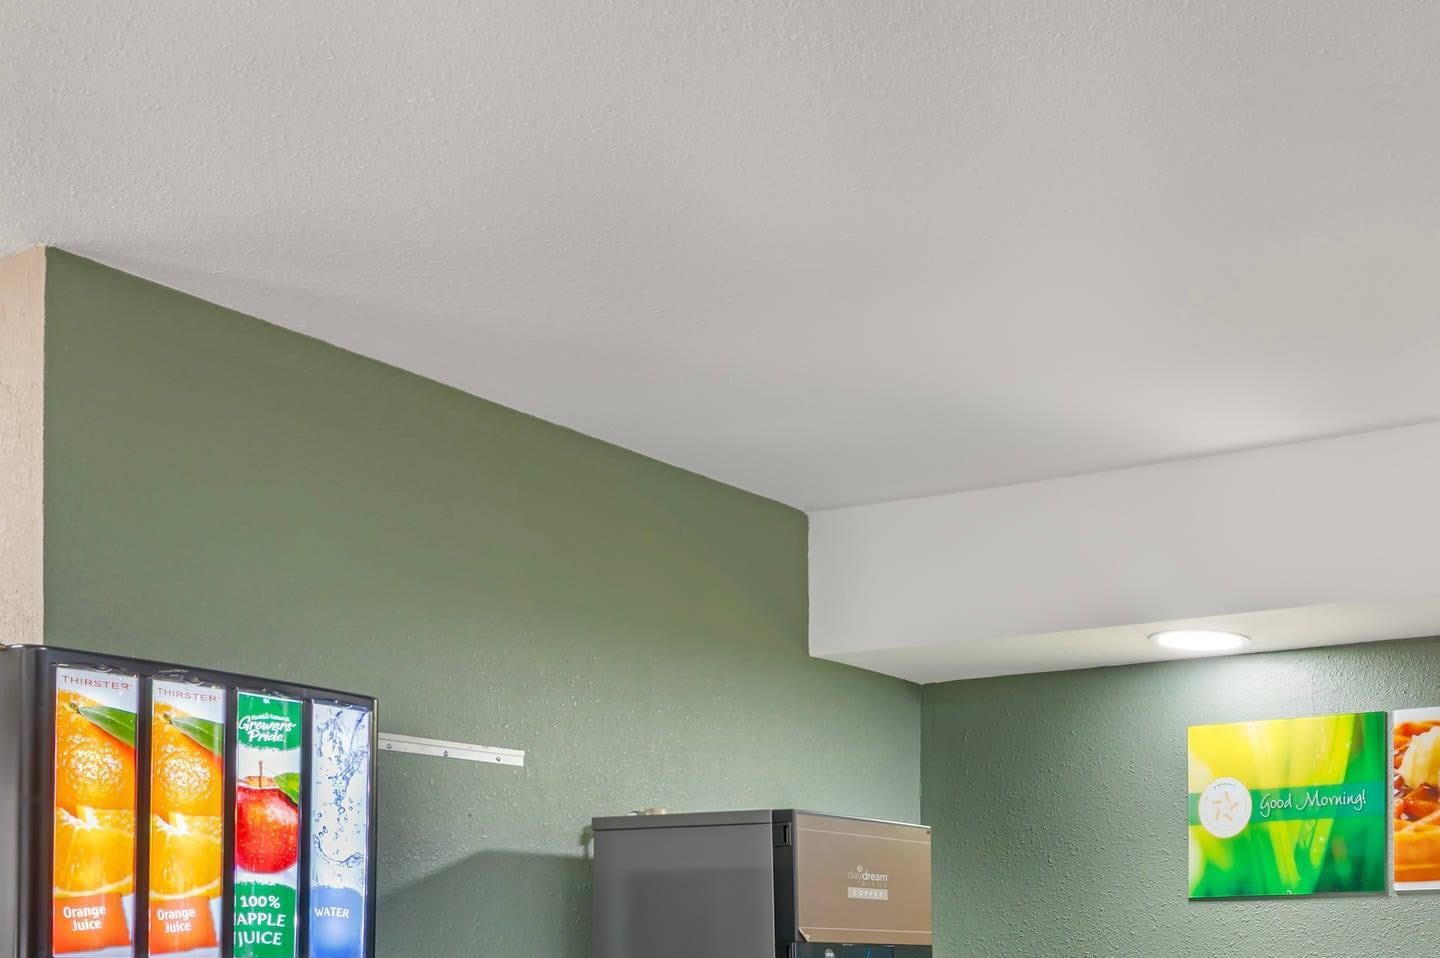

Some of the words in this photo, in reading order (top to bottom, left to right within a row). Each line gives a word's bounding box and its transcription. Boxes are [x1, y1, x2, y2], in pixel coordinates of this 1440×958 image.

[62, 675, 130, 690] THIRSTER
[157, 687, 218, 702] THIRSTER
[247, 729, 284, 742] Pride
[1260, 792, 1293, 818] Good
[1295, 789, 1367, 811] Morning!
[239, 895, 281, 909] 100%
[63, 905, 107, 919] Orange
[157, 908, 197, 921] Orange
[314, 906, 350, 919] WATER
[72, 919, 103, 932] Juice
[236, 912, 287, 928] APPLE
[164, 922, 193, 933] Juice
[238, 931, 283, 948] JUICE
